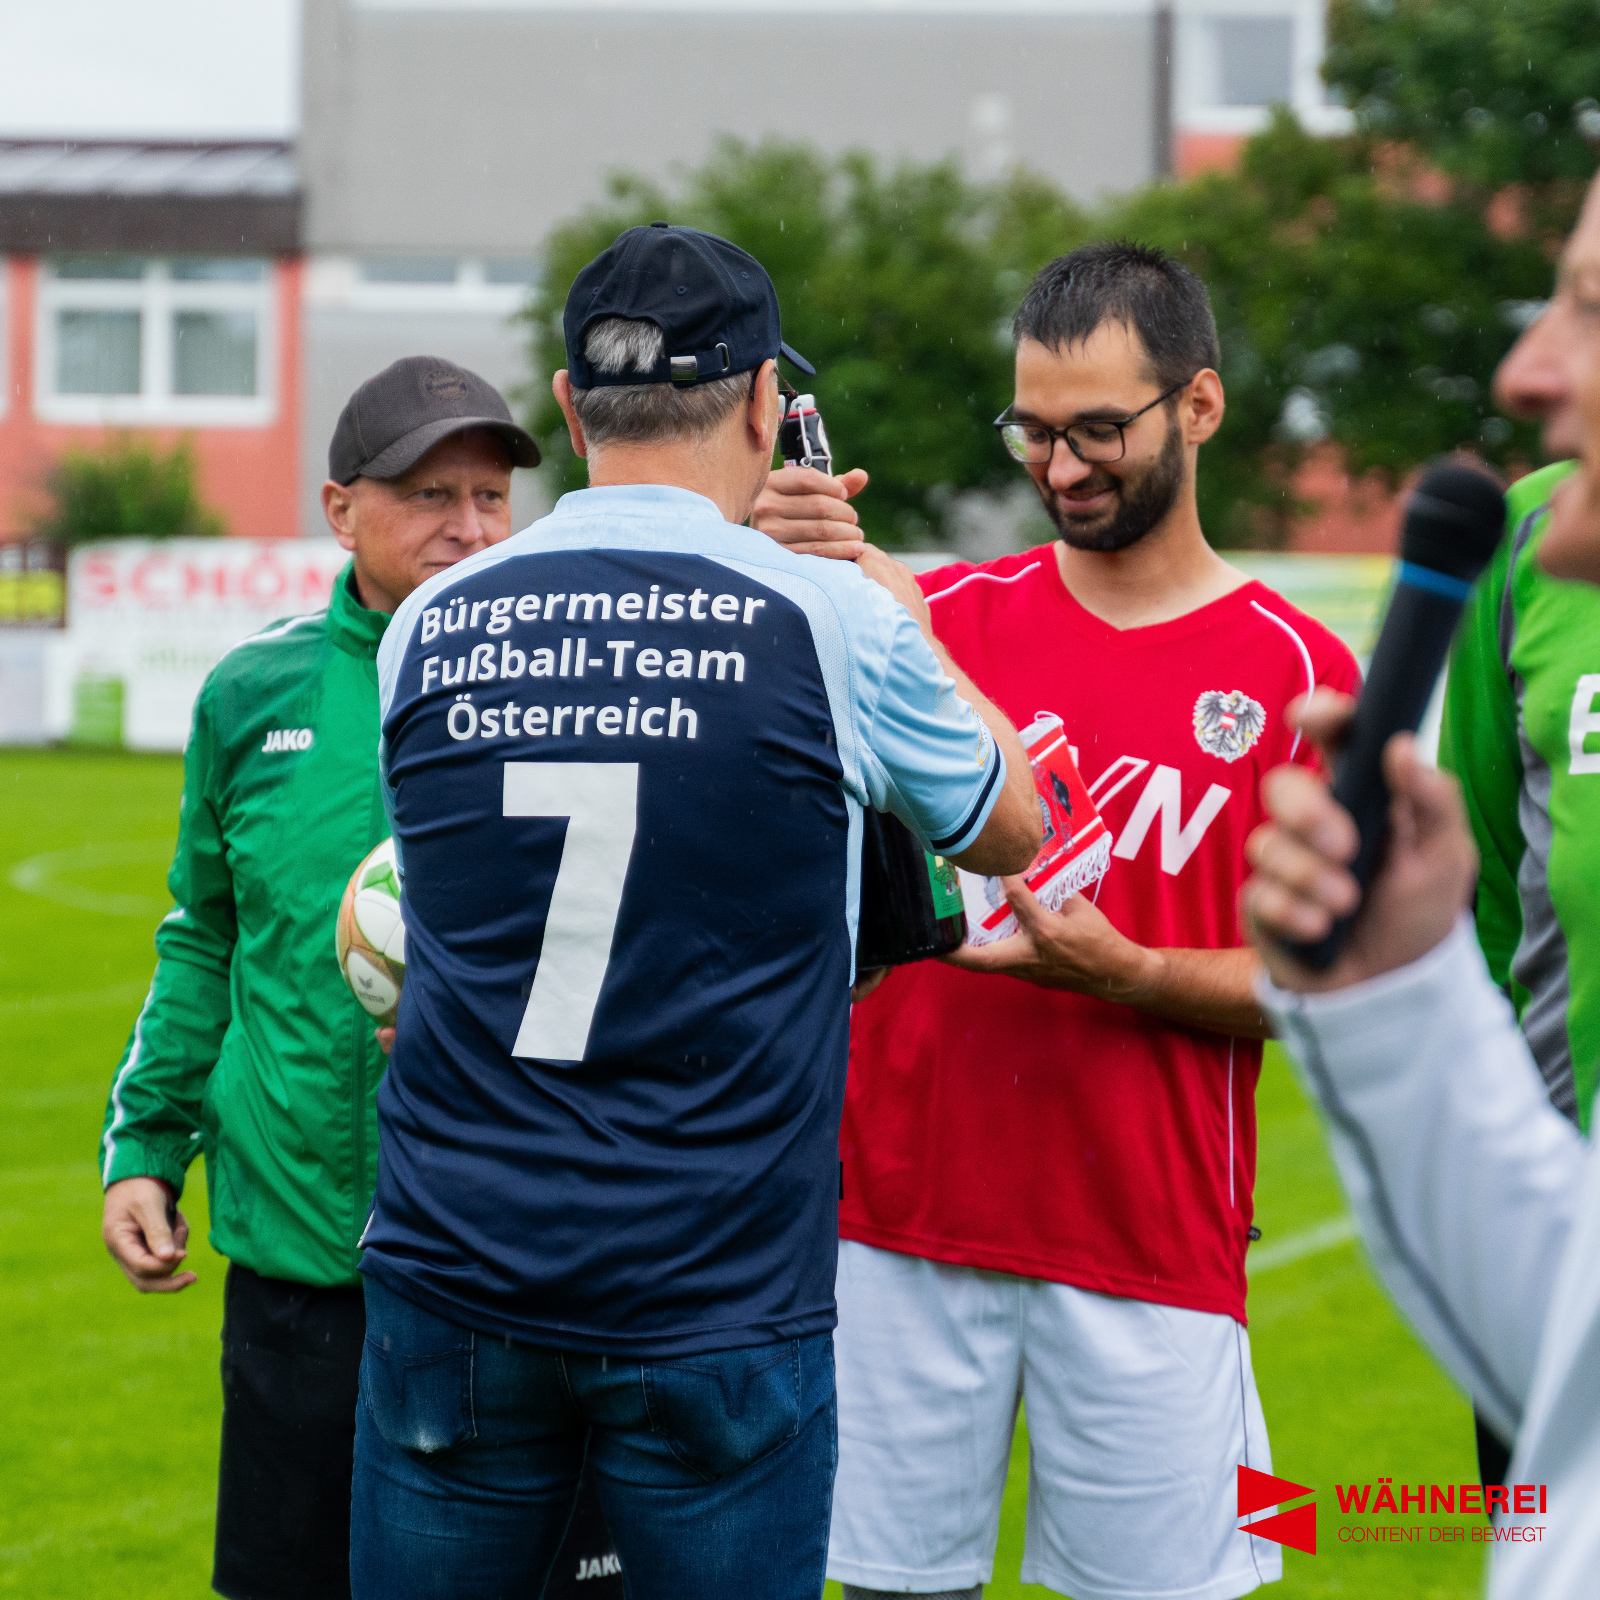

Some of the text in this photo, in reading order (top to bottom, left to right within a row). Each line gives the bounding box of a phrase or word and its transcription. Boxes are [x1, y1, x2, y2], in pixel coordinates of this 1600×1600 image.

[420, 584, 766, 645] Bürgermeister
[421, 637, 746, 694] Fußball-Team
[261, 727, 313, 753] JAKO
[447, 693, 698, 740] Österreich
[502, 761, 640, 1062] 7
